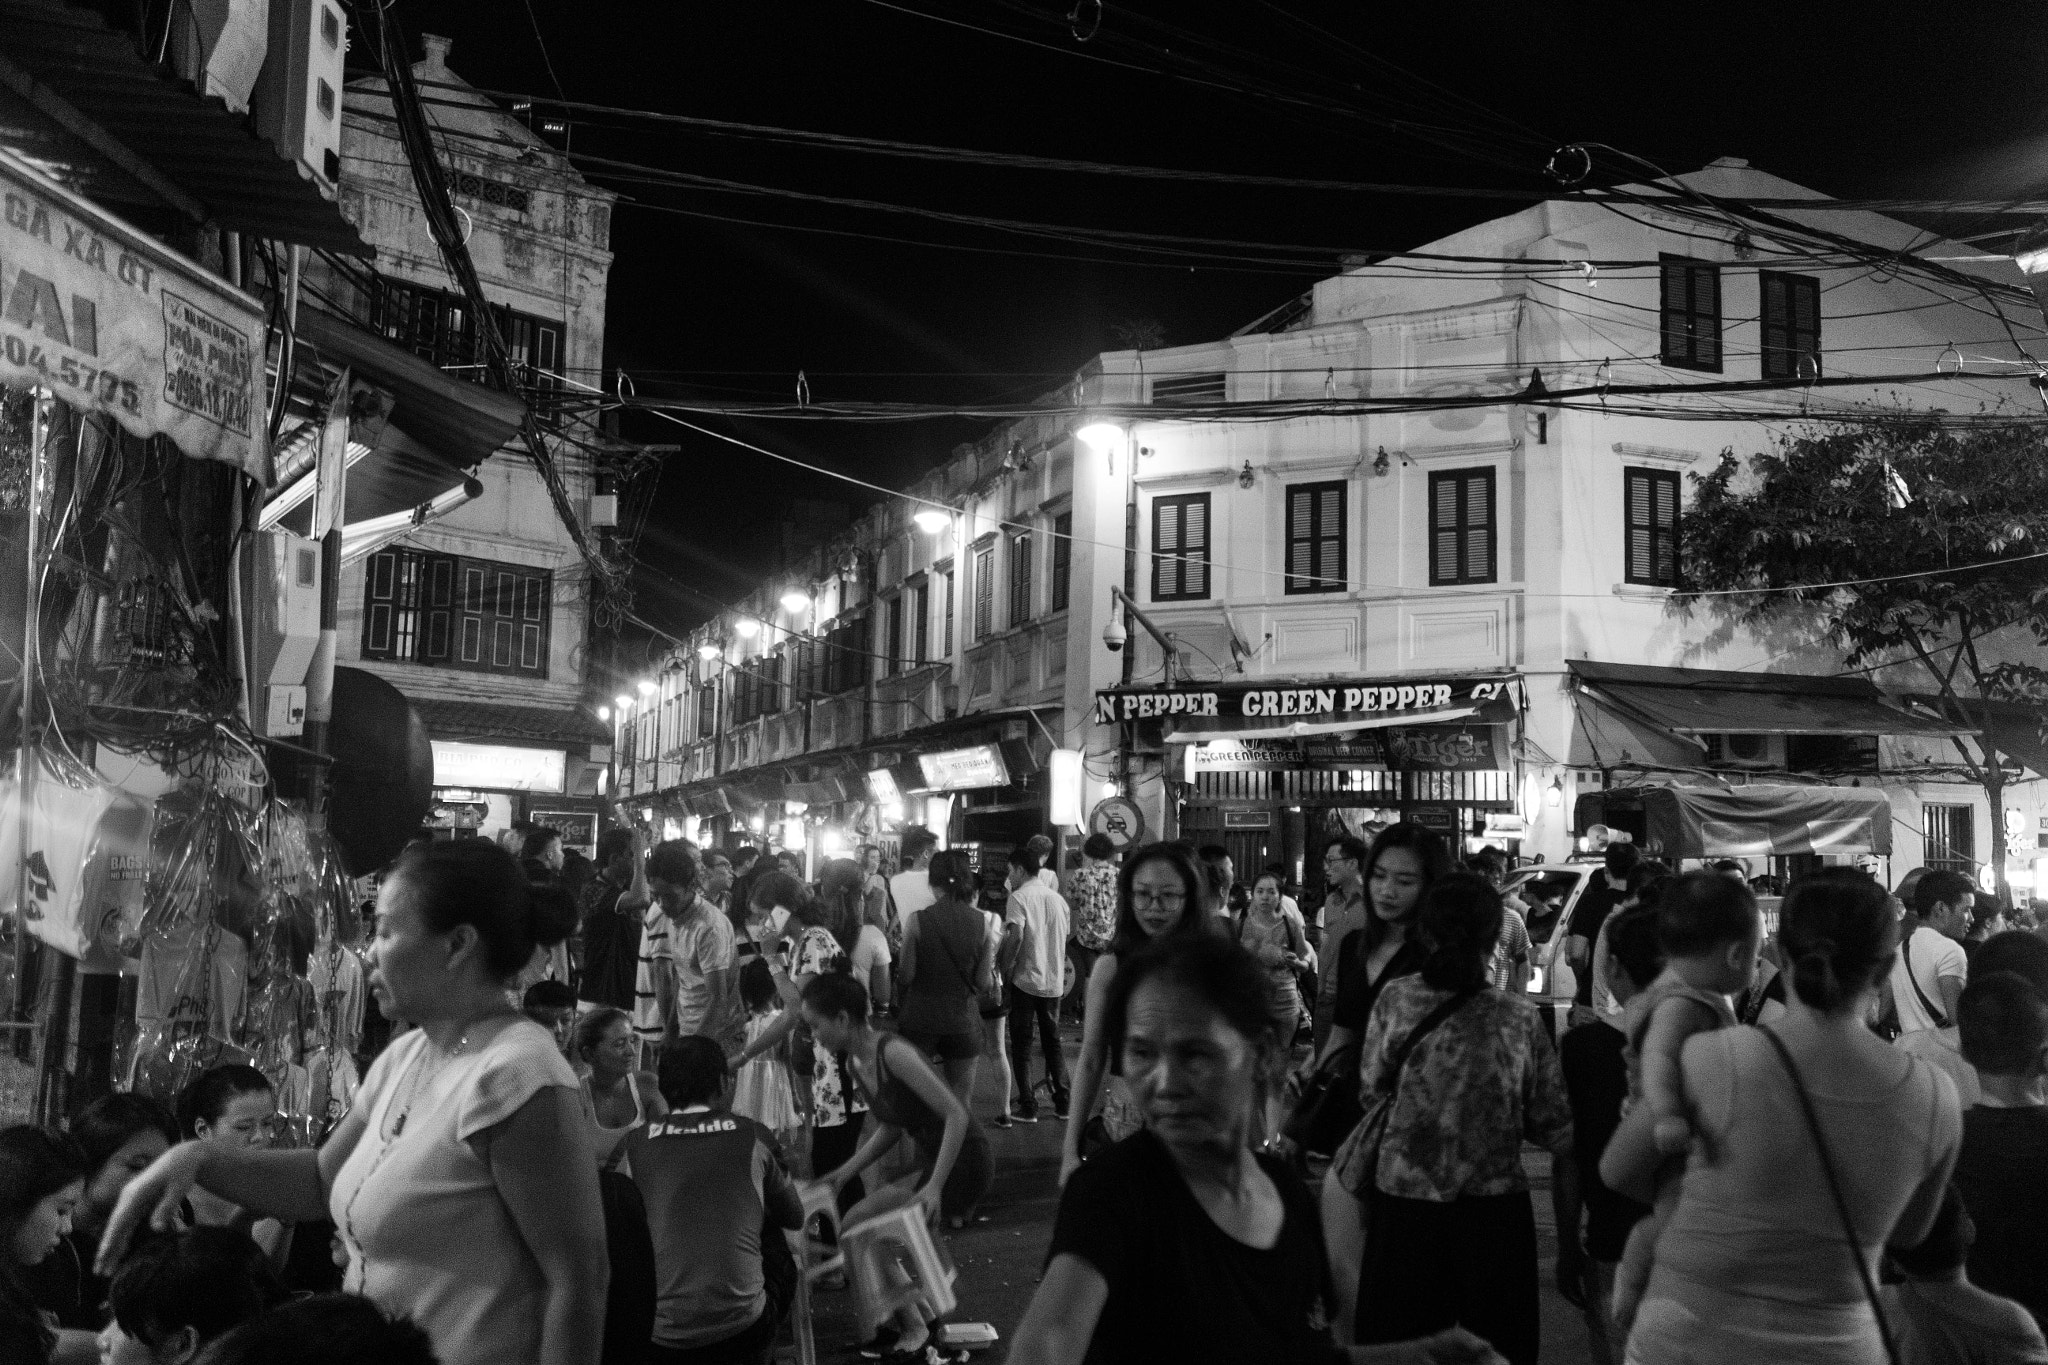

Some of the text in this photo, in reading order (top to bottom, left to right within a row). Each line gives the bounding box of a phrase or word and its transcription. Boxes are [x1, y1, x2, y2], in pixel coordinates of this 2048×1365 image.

[1122, 692, 1219, 720] PEPPER
[1242, 684, 1452, 717] GREEN PEPPER
[1408, 733, 1489, 767] Tiger
[110, 855, 143, 870] BAGS
